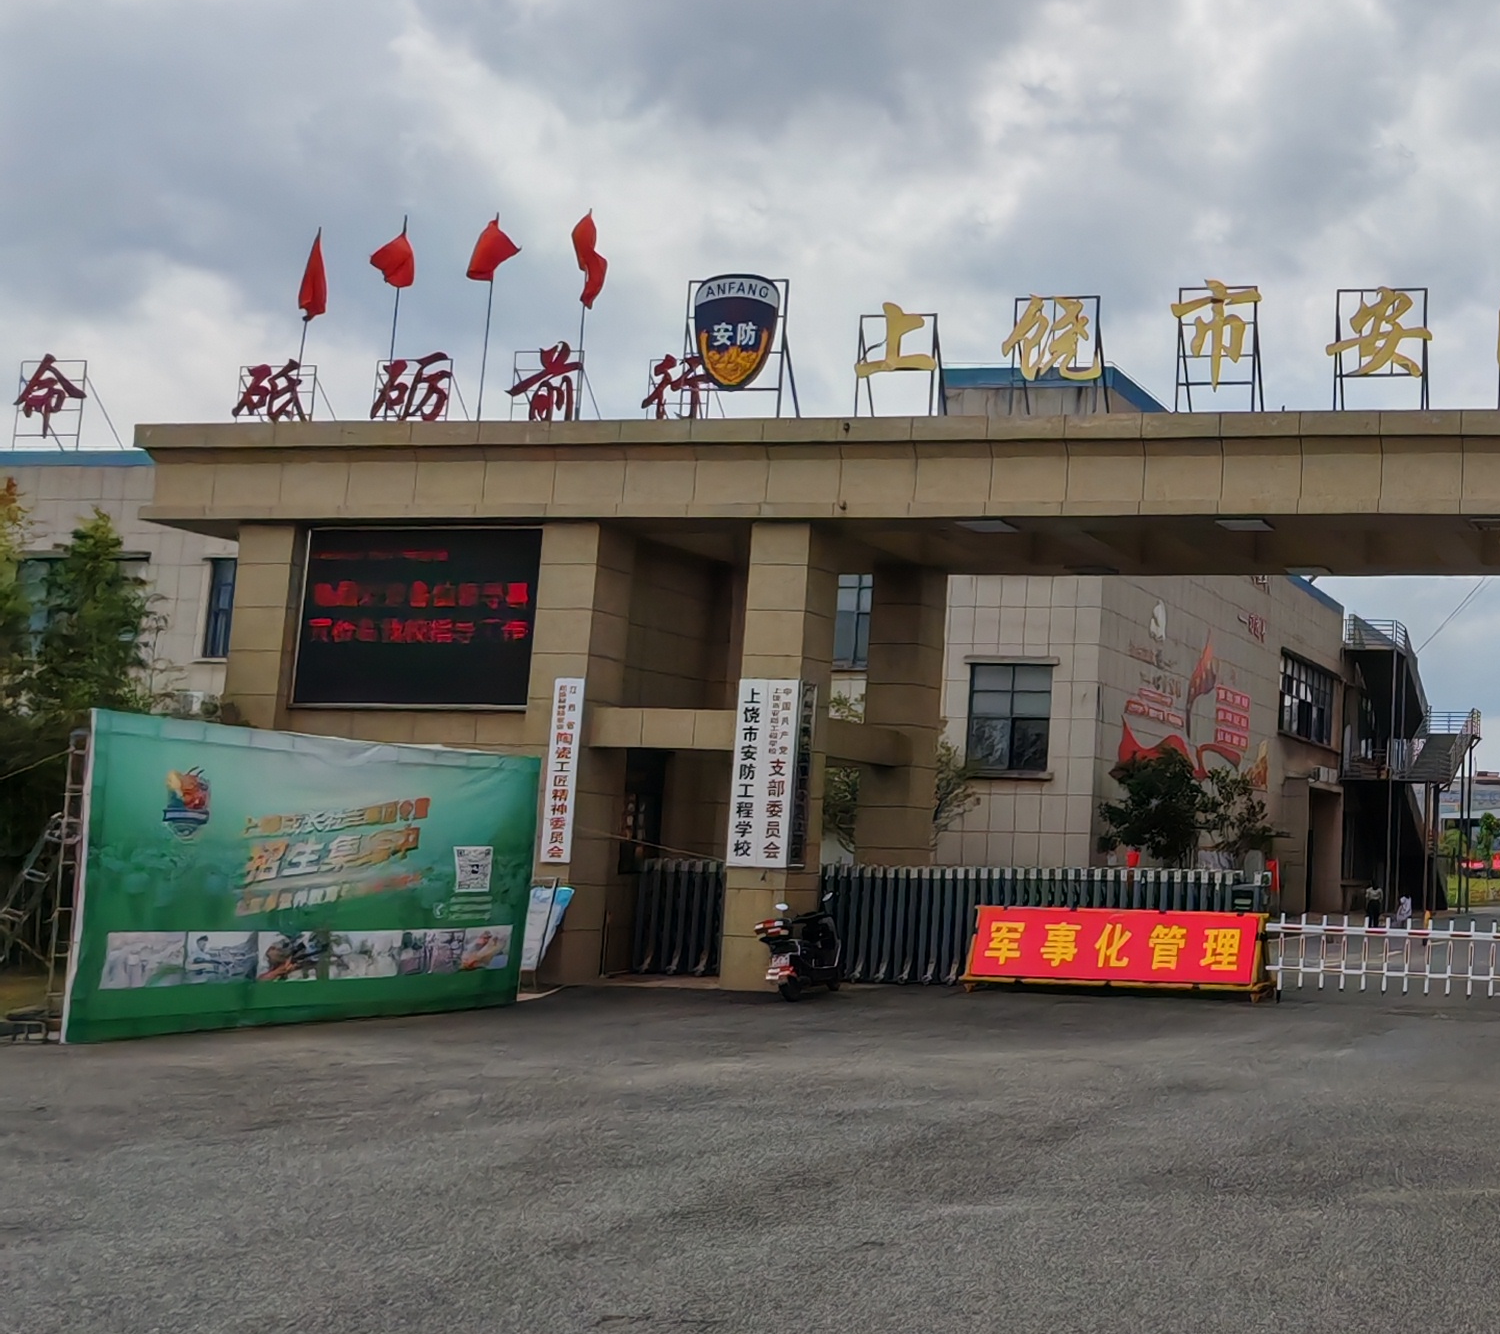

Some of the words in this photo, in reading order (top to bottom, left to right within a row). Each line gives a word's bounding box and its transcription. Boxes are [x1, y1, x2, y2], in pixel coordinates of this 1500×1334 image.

[706, 281, 769, 298] ANFANG
[712, 322, 758, 346] 安防
[12, 353, 87, 438] 命
[230, 340, 710, 423] 砥砺前行
[779, 688, 793, 755] 中国共产党
[547, 732, 573, 858] 陶瓷工匠精神委员会
[733, 688, 761, 857] 上饶市安防工程学校
[763, 758, 786, 859] 支部委员会
[984, 920, 1241, 971] 军事化管理
